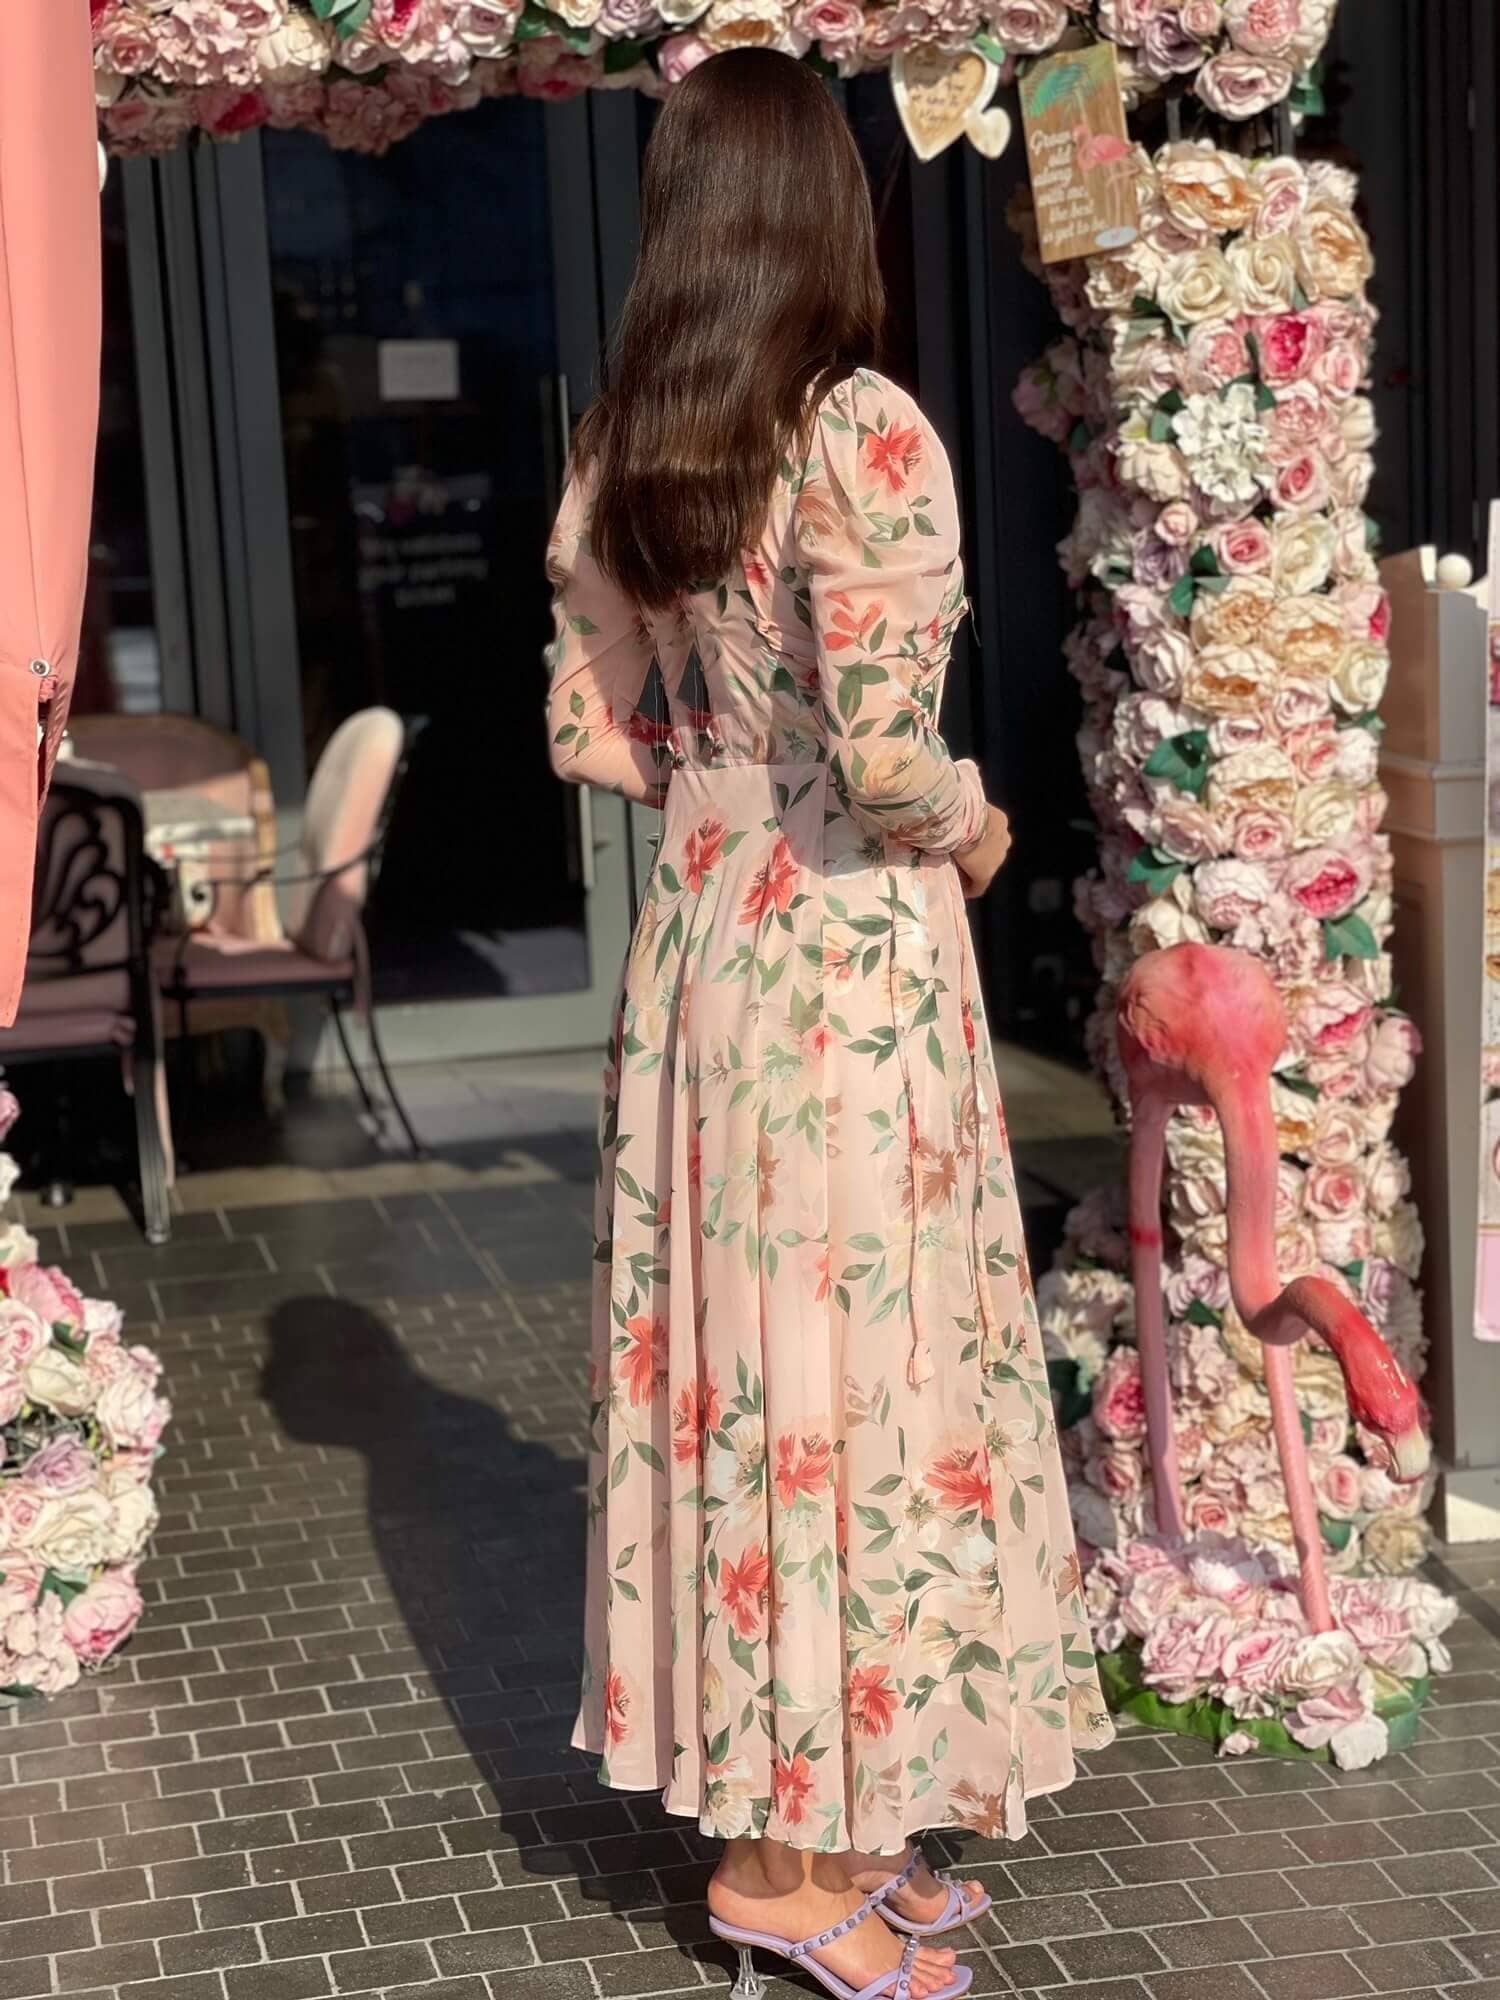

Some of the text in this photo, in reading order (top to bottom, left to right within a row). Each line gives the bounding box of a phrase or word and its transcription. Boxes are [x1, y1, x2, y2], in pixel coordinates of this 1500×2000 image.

[1050, 199, 1094, 223] the best
[1076, 220, 1089, 234] to
